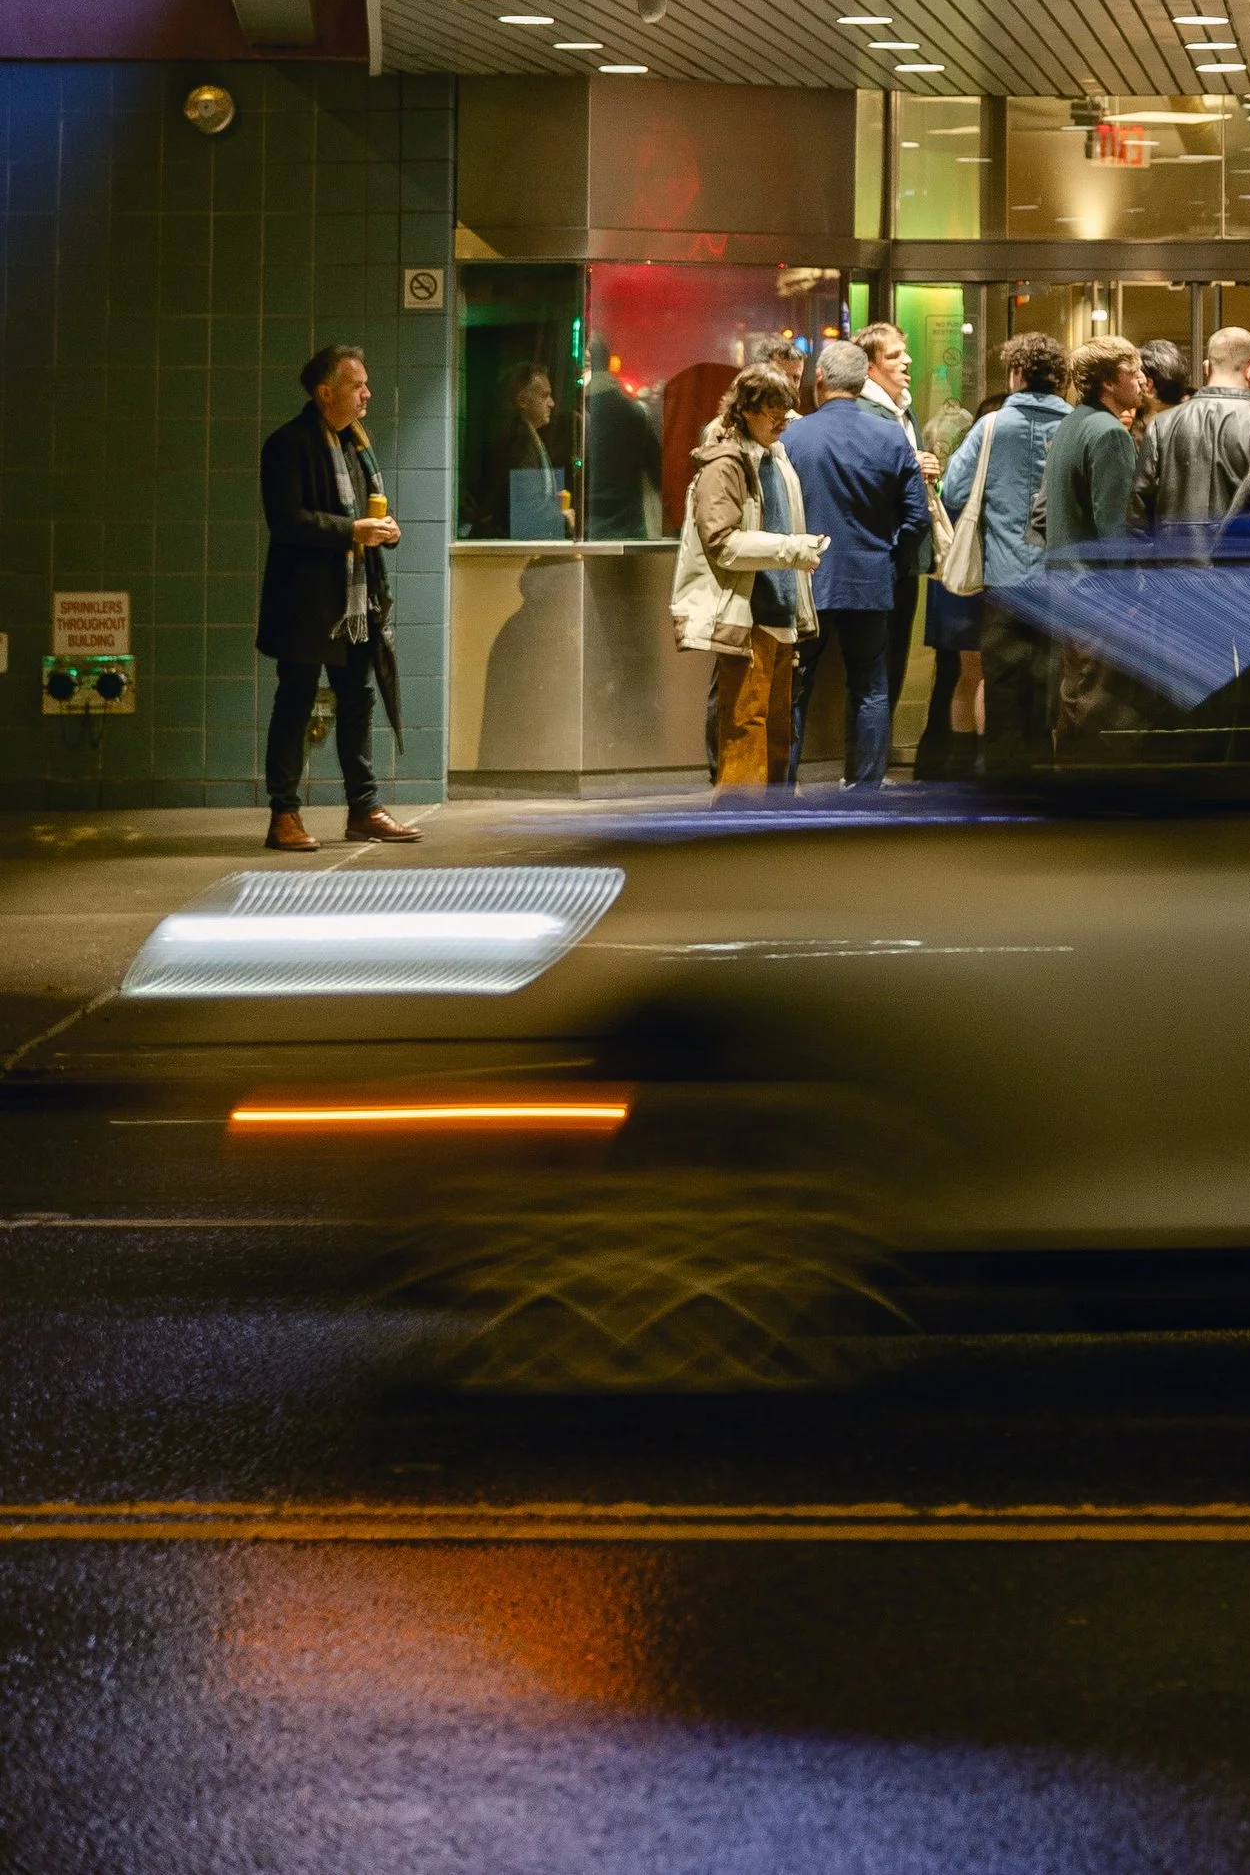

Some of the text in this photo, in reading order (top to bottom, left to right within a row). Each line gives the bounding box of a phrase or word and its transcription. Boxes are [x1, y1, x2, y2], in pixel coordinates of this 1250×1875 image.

[60, 601, 123, 614] SPRINKLERS
[57, 617, 127, 630] THROUGHOUT
[68, 634, 115, 647] BUILDING
